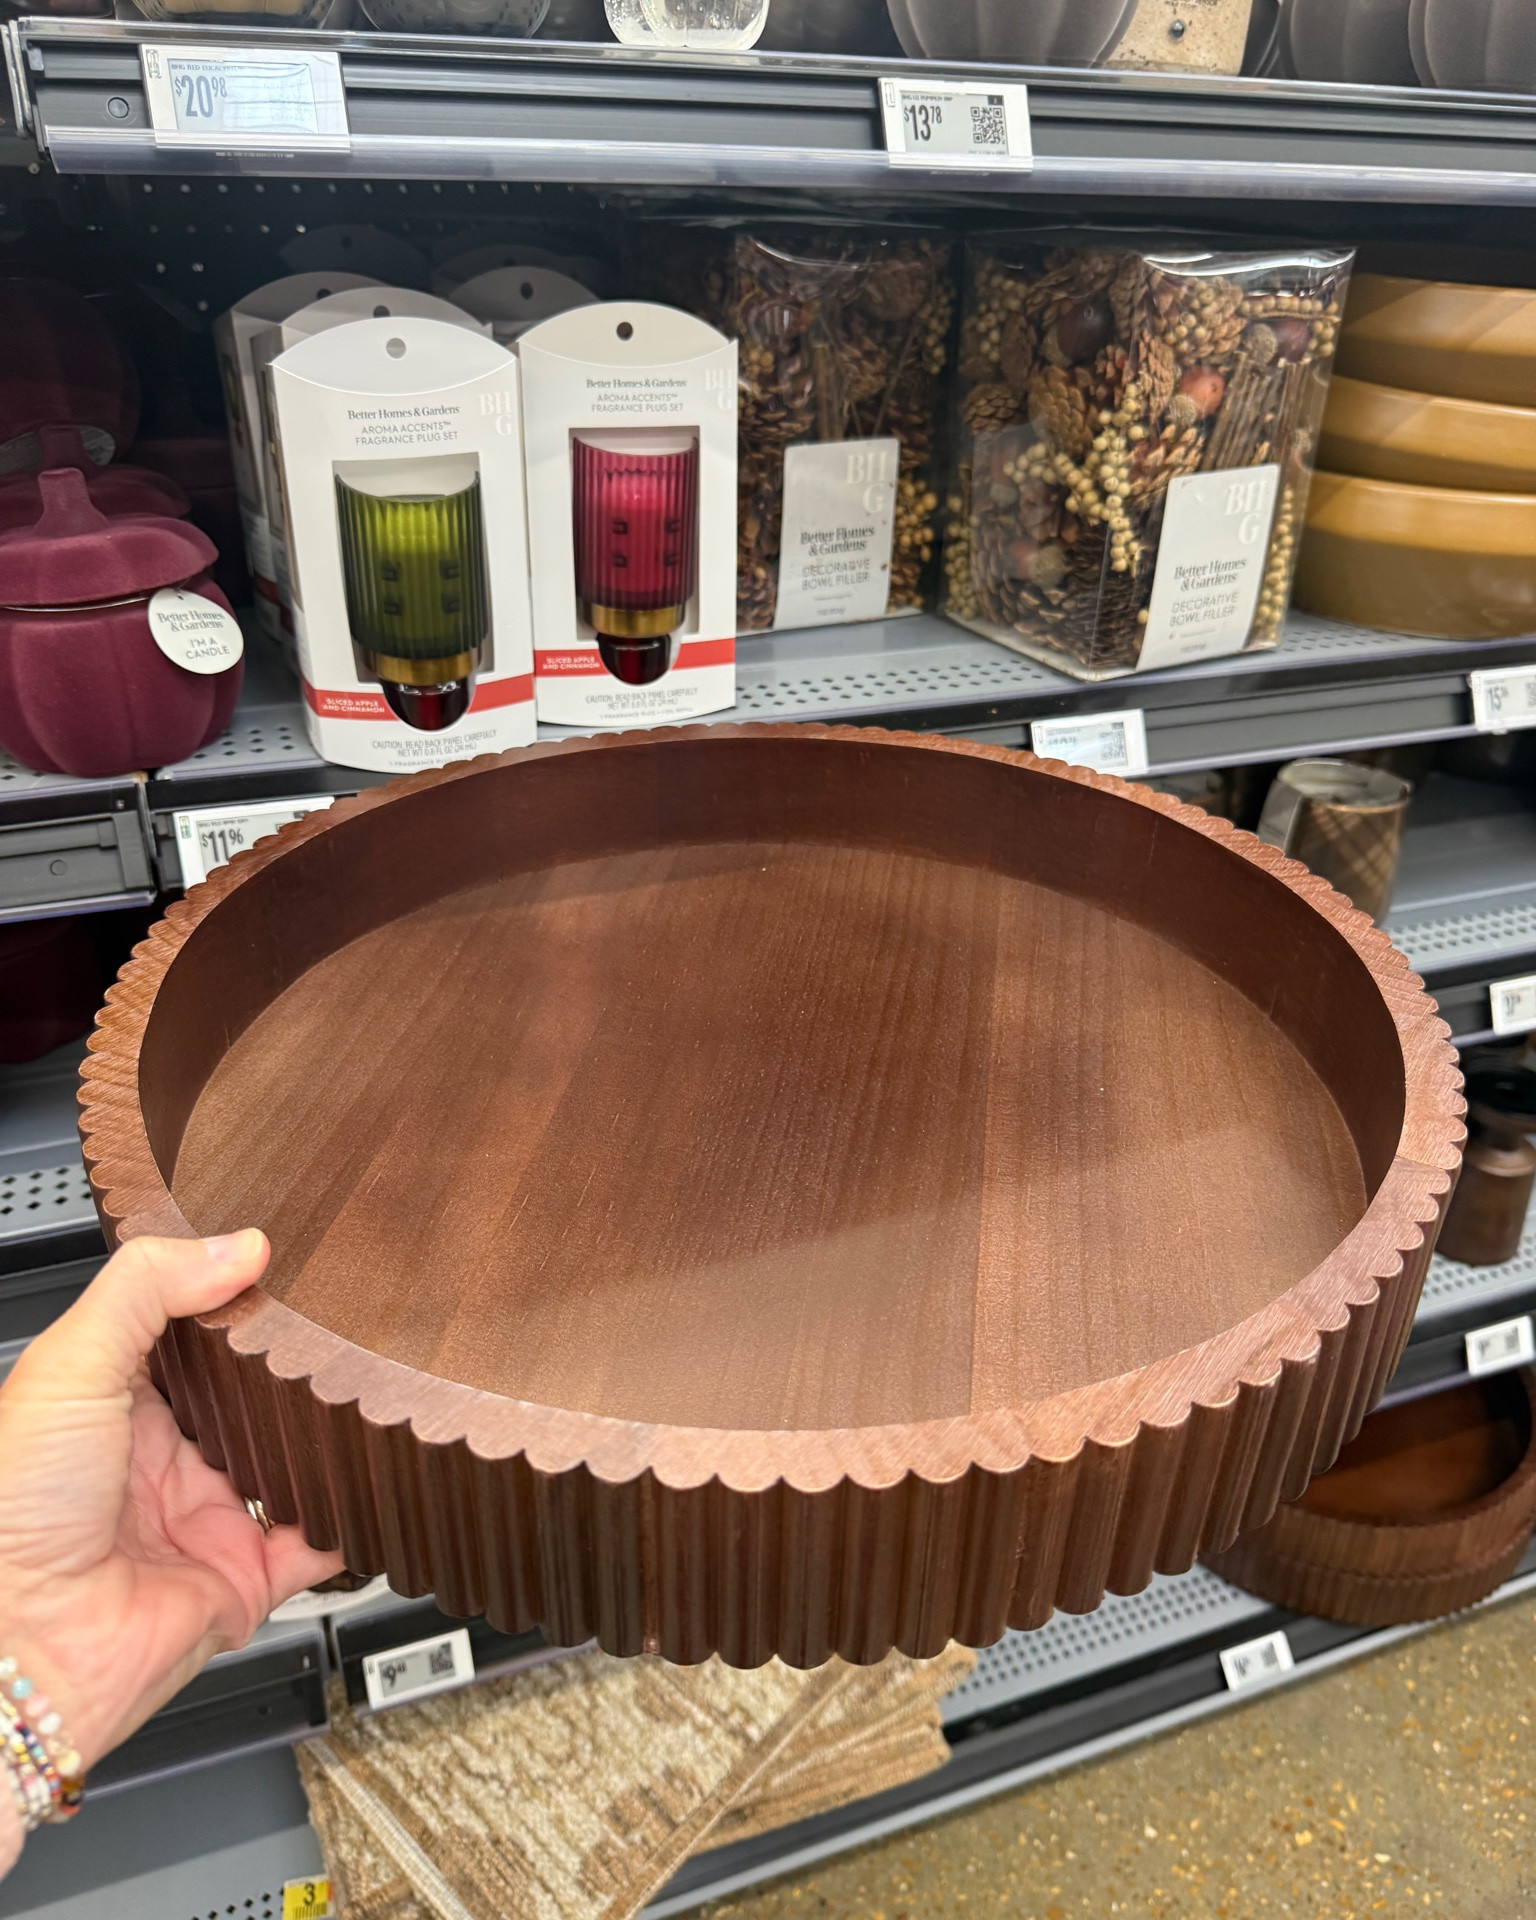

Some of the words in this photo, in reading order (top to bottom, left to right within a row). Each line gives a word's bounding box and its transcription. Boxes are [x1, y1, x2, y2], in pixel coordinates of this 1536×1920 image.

[586, 380, 611, 388] Better
[614, 380, 642, 388] Homes
[597, 394, 629, 402] AROMA
[348, 408, 377, 420] Better
[379, 408, 412, 419] Homes
[591, 404, 643, 412] FRAGRANCE
[646, 404, 667, 412] PLUG
[669, 403, 683, 411] SET
[362, 425, 399, 434] AROMA
[356, 434, 414, 446] FRAGRANCE
[418, 433, 441, 442] PLUG
[443, 432, 458, 440] SET
[800, 530, 834, 545] Better
[836, 525, 874, 540] Homes
[803, 559, 870, 578] DECORATIVE
[1174, 564, 1208, 580] Better
[1209, 558, 1246, 574] Homes
[802, 576, 834, 590] BOWL
[836, 571, 870, 586] FILLER
[1172, 592, 1239, 614] DECORATIVE
[157, 613, 187, 623] Better
[190, 611, 225, 620] Homes
[1169, 610, 1200, 626] BOWL
[1203, 605, 1235, 620] FILLER
[180, 620, 223, 630] Gardens
[190, 638, 206, 648] I'M
[210, 637, 217, 645] A
[186, 646, 230, 659] CANDLE
[405, 741, 424, 749] READ
[443, 737, 463, 746] PANEL
[464, 729, 497, 742] CAREFULLY
[398, 749, 411, 757] NET
[303, 1882, 316, 1905] 3
